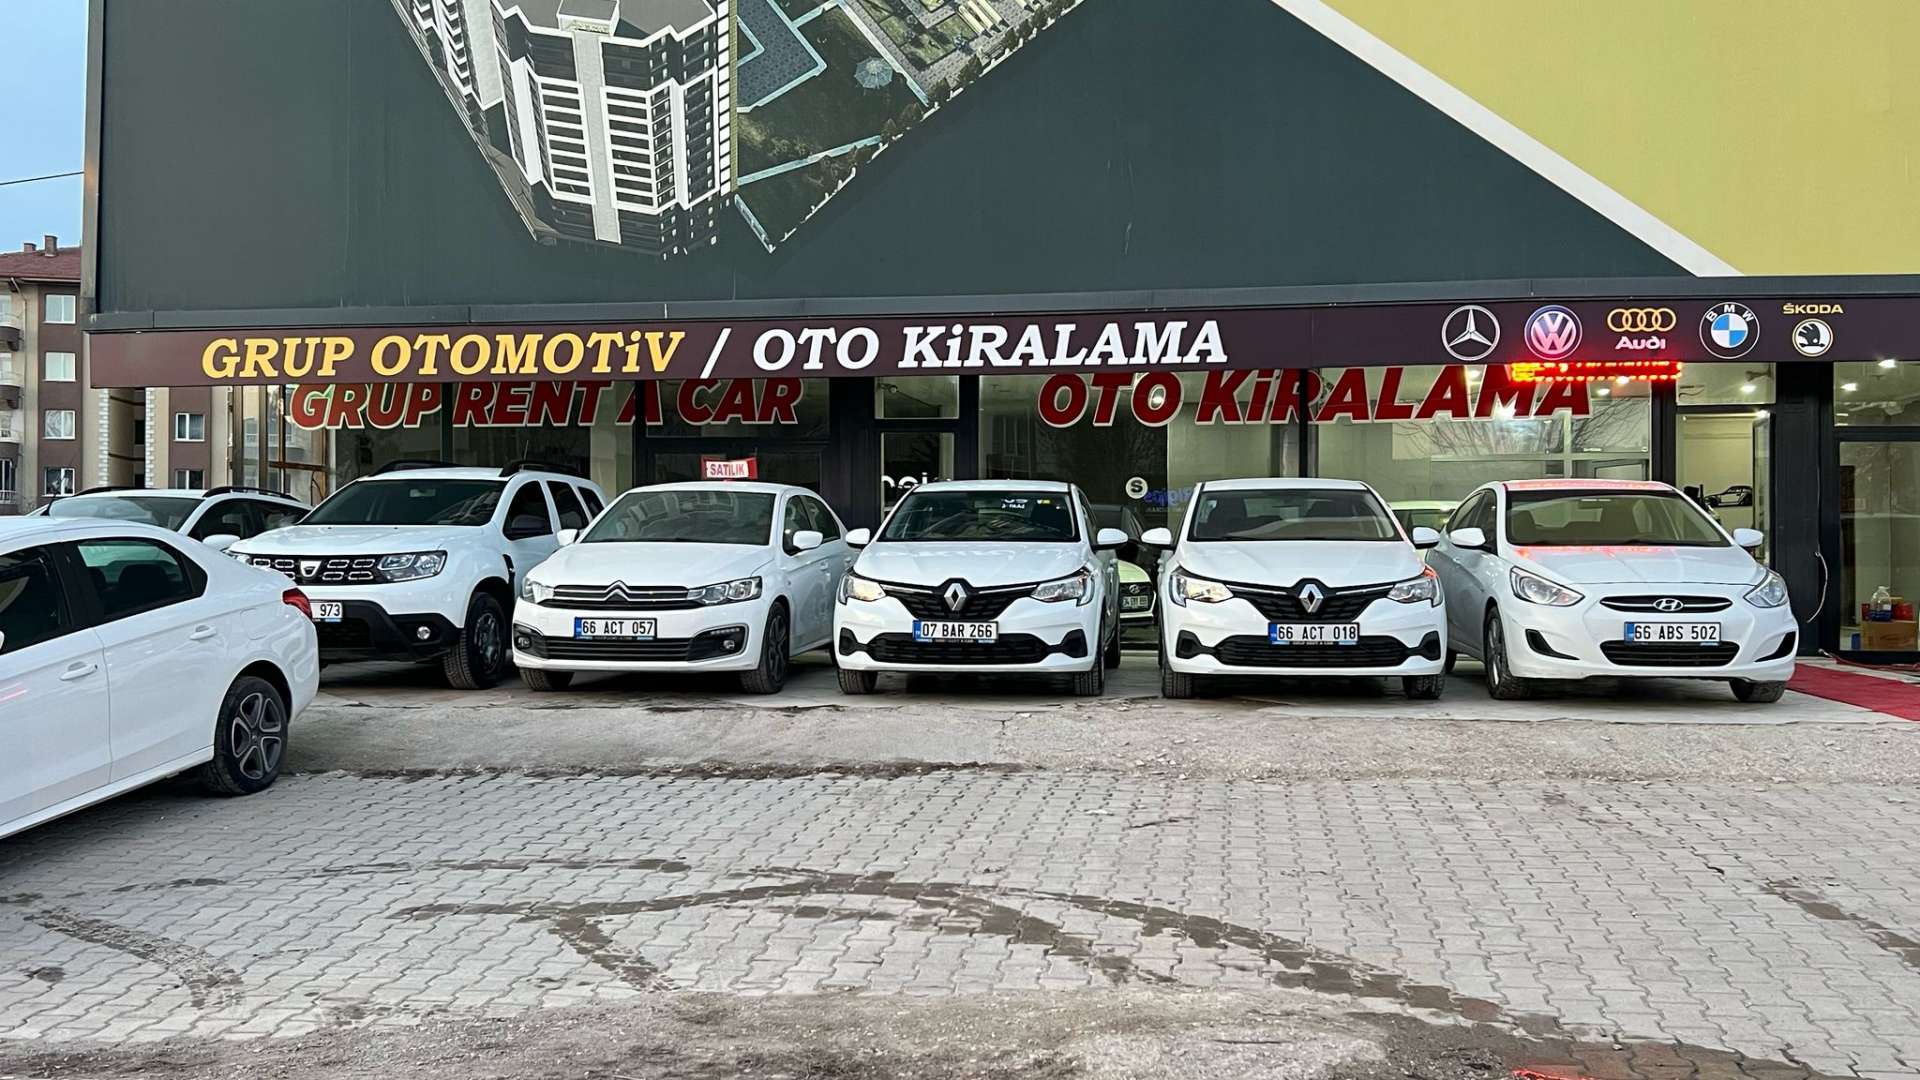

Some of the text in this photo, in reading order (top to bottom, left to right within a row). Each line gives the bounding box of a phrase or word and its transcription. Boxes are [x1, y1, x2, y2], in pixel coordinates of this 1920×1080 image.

[1705, 304, 1755, 322] BMW
[202, 320, 1228, 379] GRUP OTOMOTiV / OTO KiRALAMA
[1615, 336, 1666, 350] Audi
[1038, 364, 1592, 428] OTO KiRALAMA
[290, 378, 804, 430] GRUP RENT A CAR
[710, 463, 744, 476] SATILIK
[320, 603, 341, 617] 973
[582, 621, 653, 635] 66 ACT 057
[922, 623, 993, 638] 07 BAR 266
[1278, 626, 1356, 640] 66 ACT 018
[1634, 625, 1717, 640] 66 ABS 502
